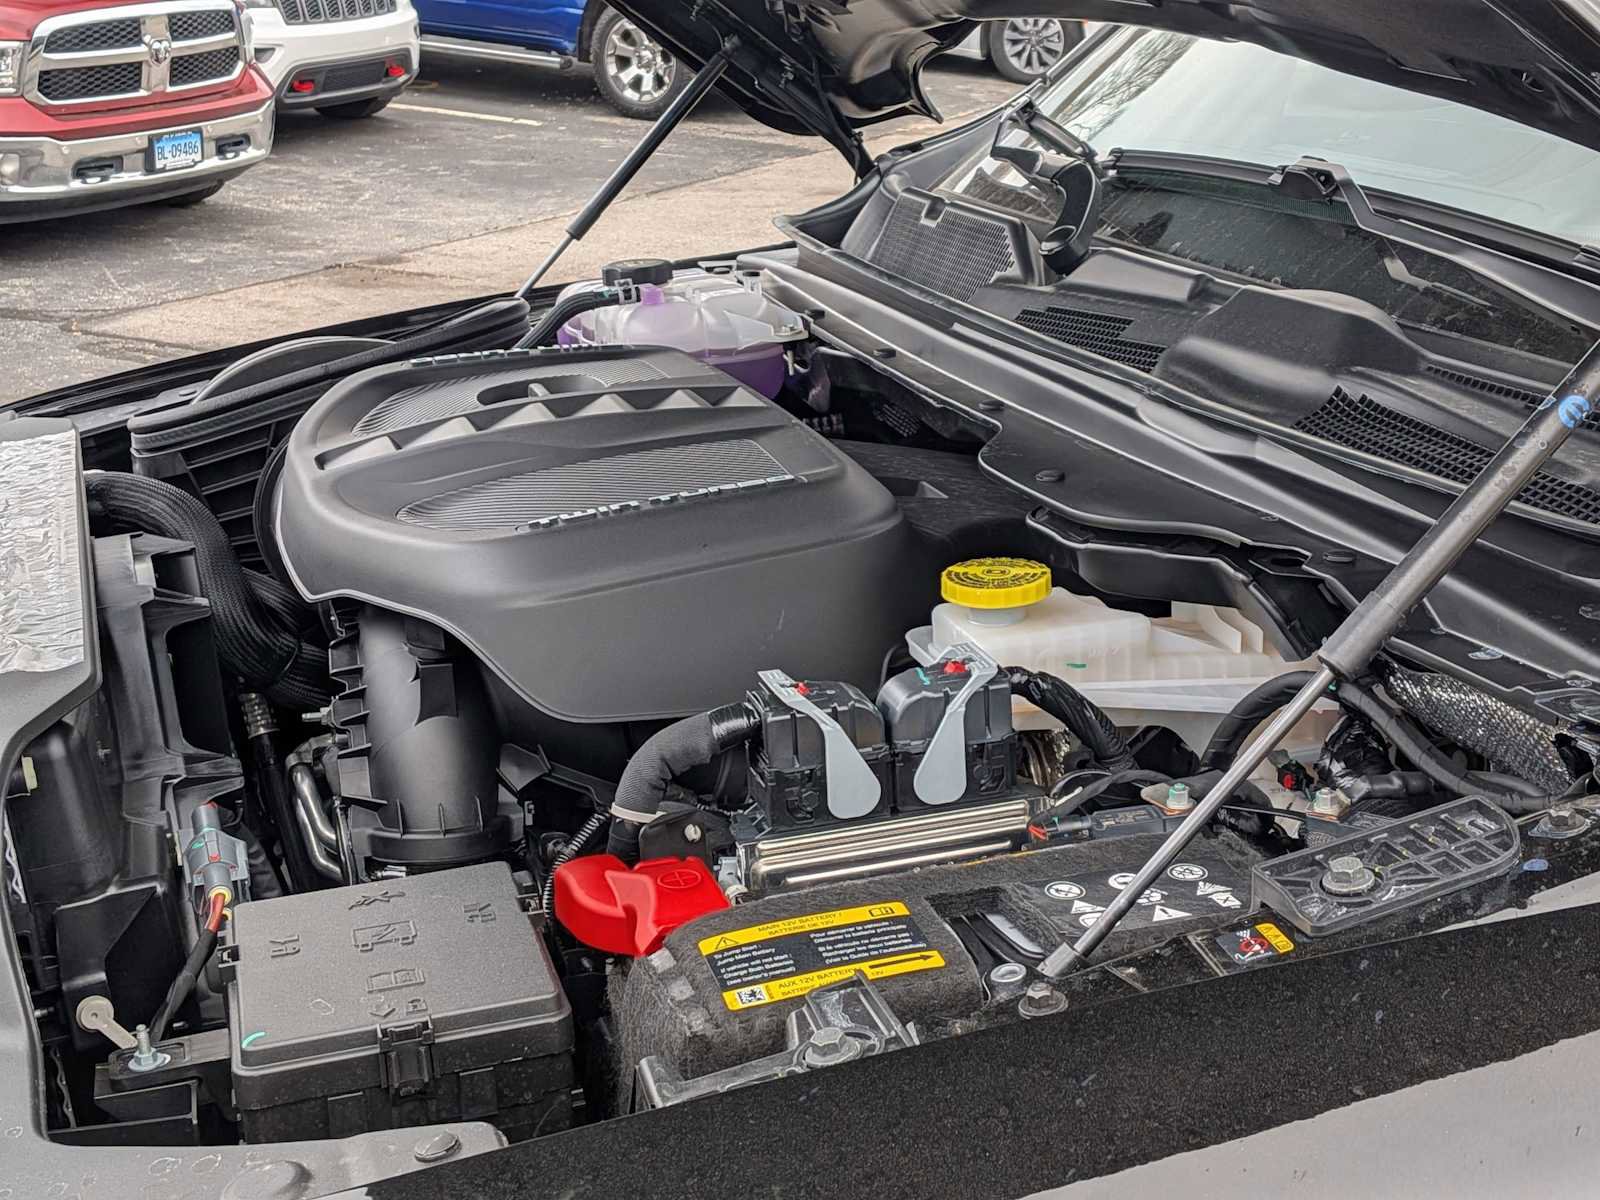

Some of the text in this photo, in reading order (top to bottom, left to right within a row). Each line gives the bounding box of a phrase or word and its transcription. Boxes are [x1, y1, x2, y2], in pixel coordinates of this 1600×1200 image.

[799, 914, 836, 924] BATTERY
[723, 949, 741, 957] Jump
[779, 980, 798, 989] AUX
